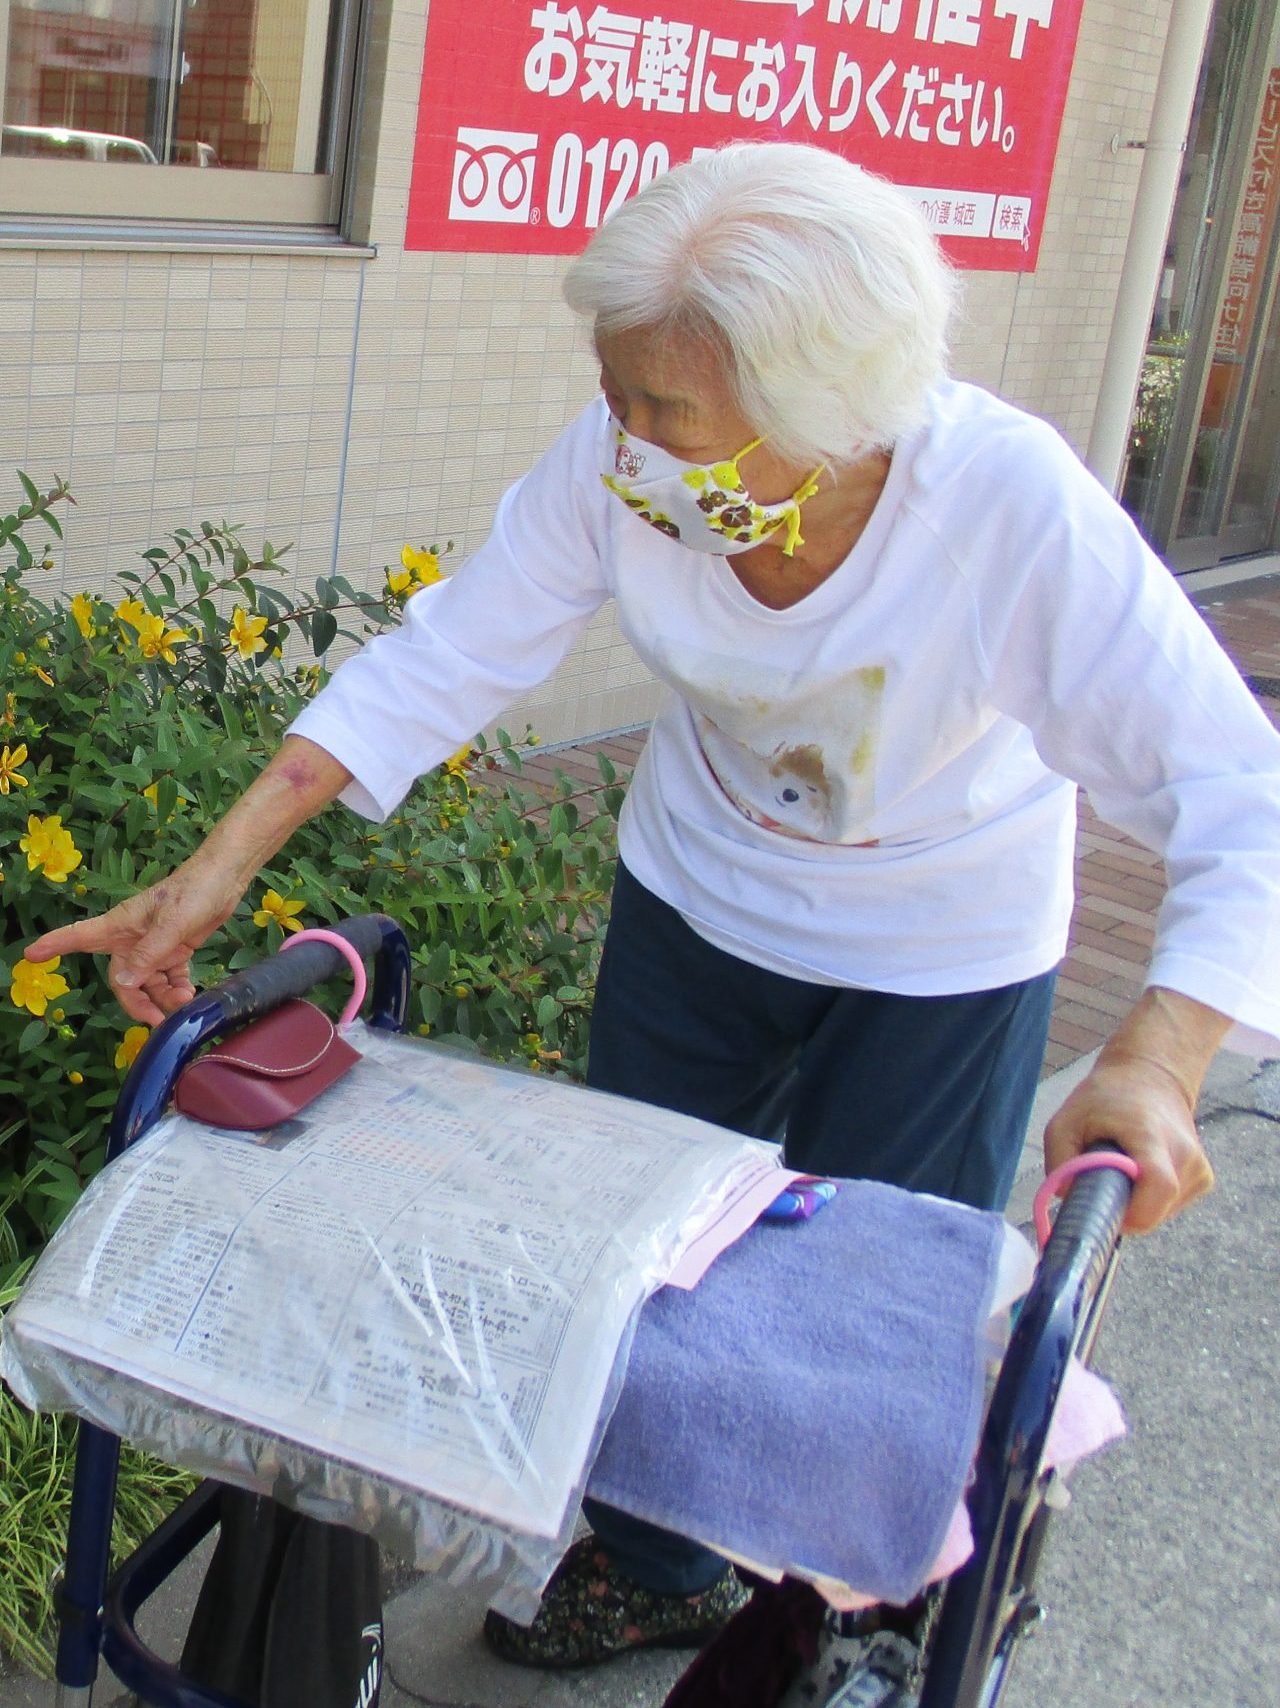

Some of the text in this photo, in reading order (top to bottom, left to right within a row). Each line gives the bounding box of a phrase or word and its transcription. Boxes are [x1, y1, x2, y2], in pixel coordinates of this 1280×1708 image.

[524, 1, 1015, 153] お気軽にお入りください。
[999, 204, 1024, 232] 検索
